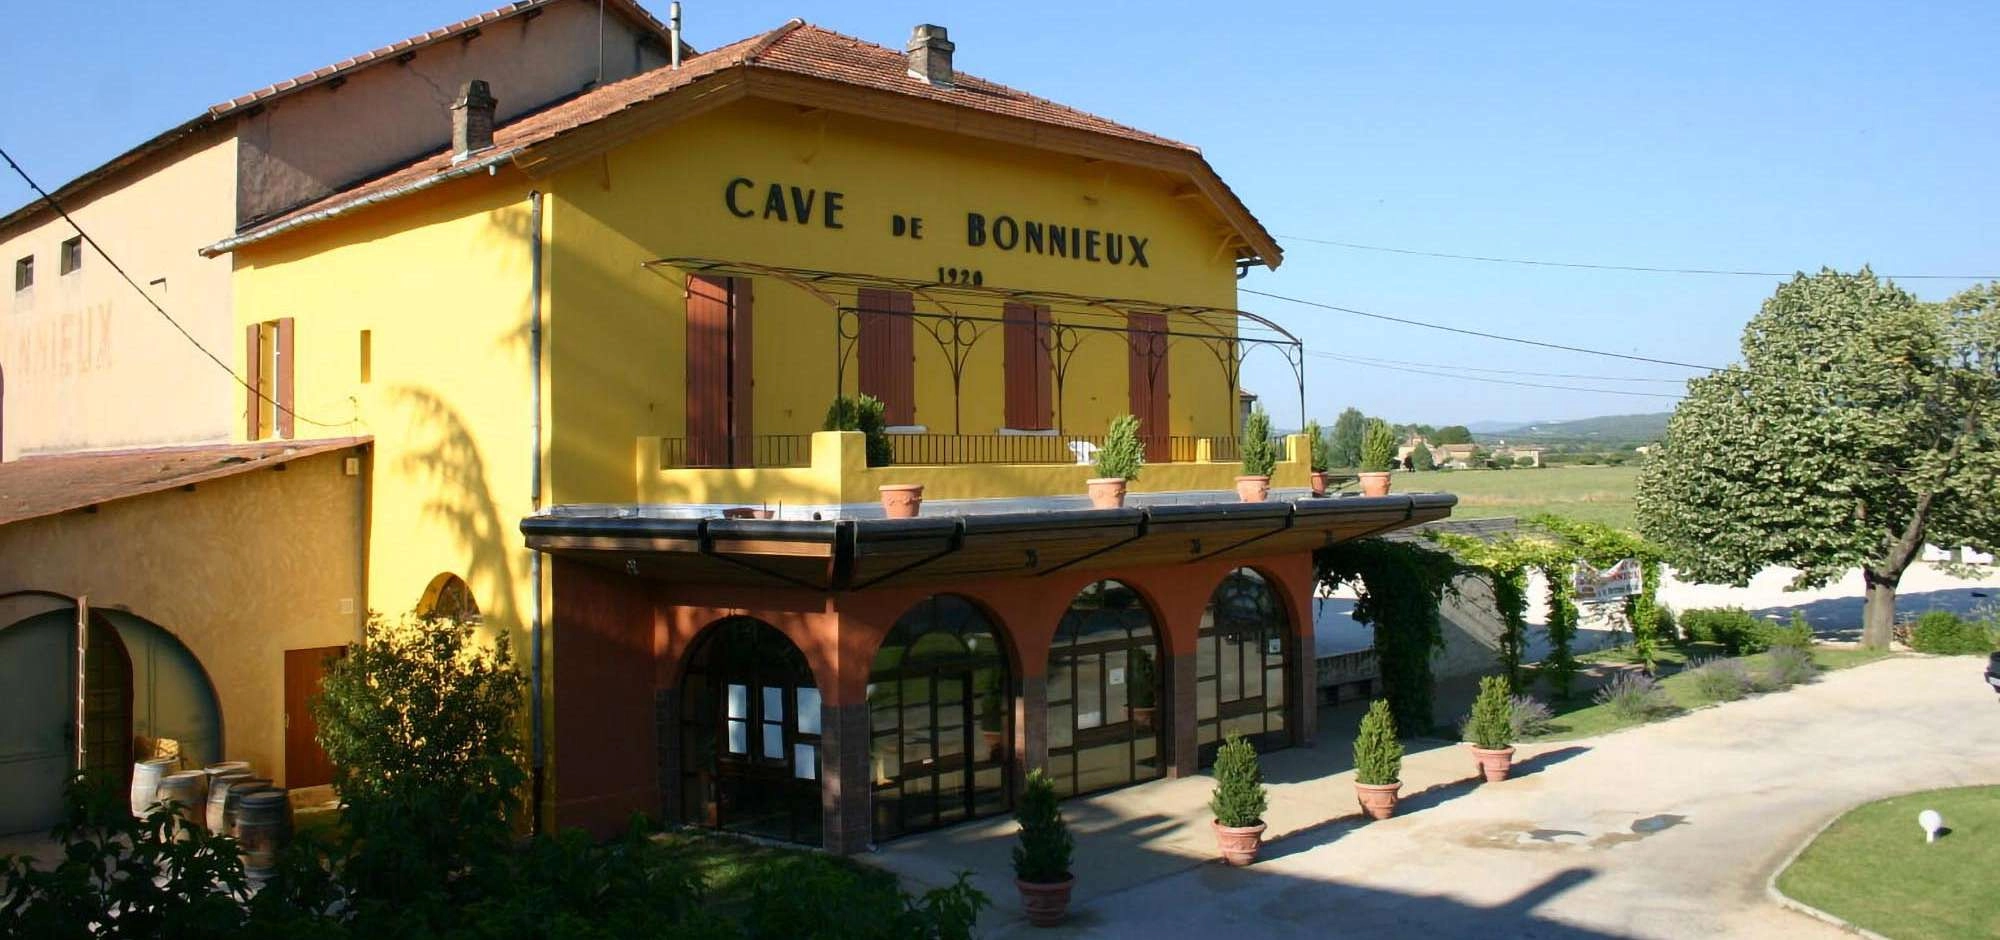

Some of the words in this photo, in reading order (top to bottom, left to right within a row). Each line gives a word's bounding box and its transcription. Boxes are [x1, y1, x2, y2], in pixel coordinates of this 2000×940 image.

[724, 176, 845, 230] CAVE
[892, 214, 924, 240] DE
[967, 212, 1150, 268] BONNIEUX
[938, 266, 983, 288] 1920
